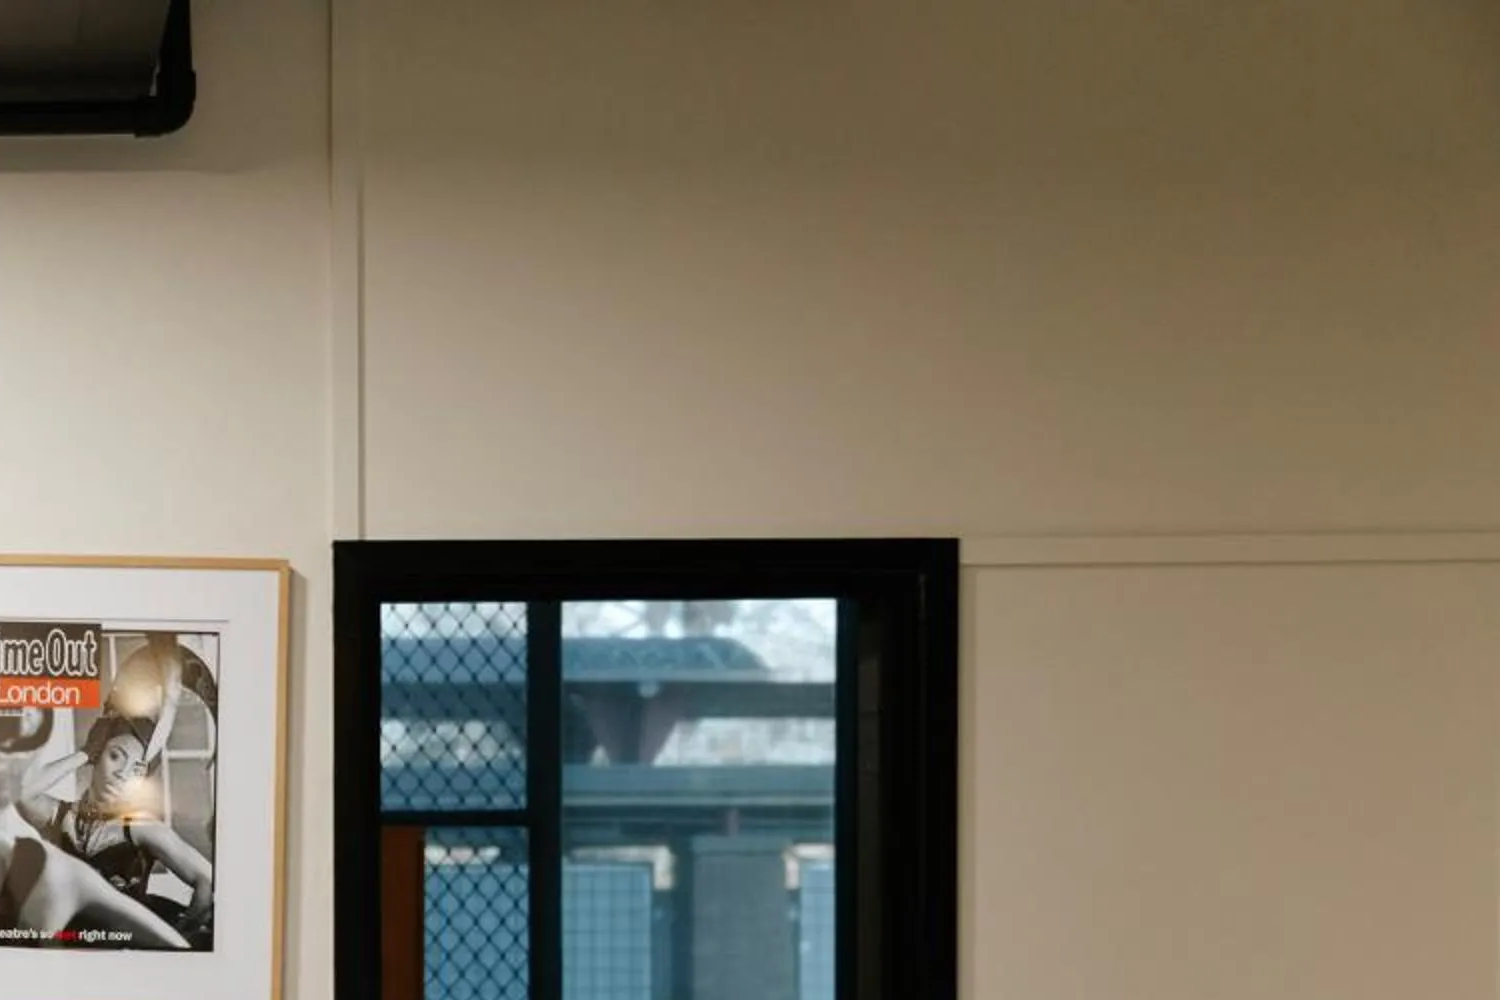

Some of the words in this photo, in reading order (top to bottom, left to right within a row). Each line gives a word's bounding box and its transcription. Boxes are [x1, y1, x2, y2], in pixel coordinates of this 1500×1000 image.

[46, 628, 99, 677] Out
[77, 929, 107, 943] right
[107, 930, 133, 942] now
